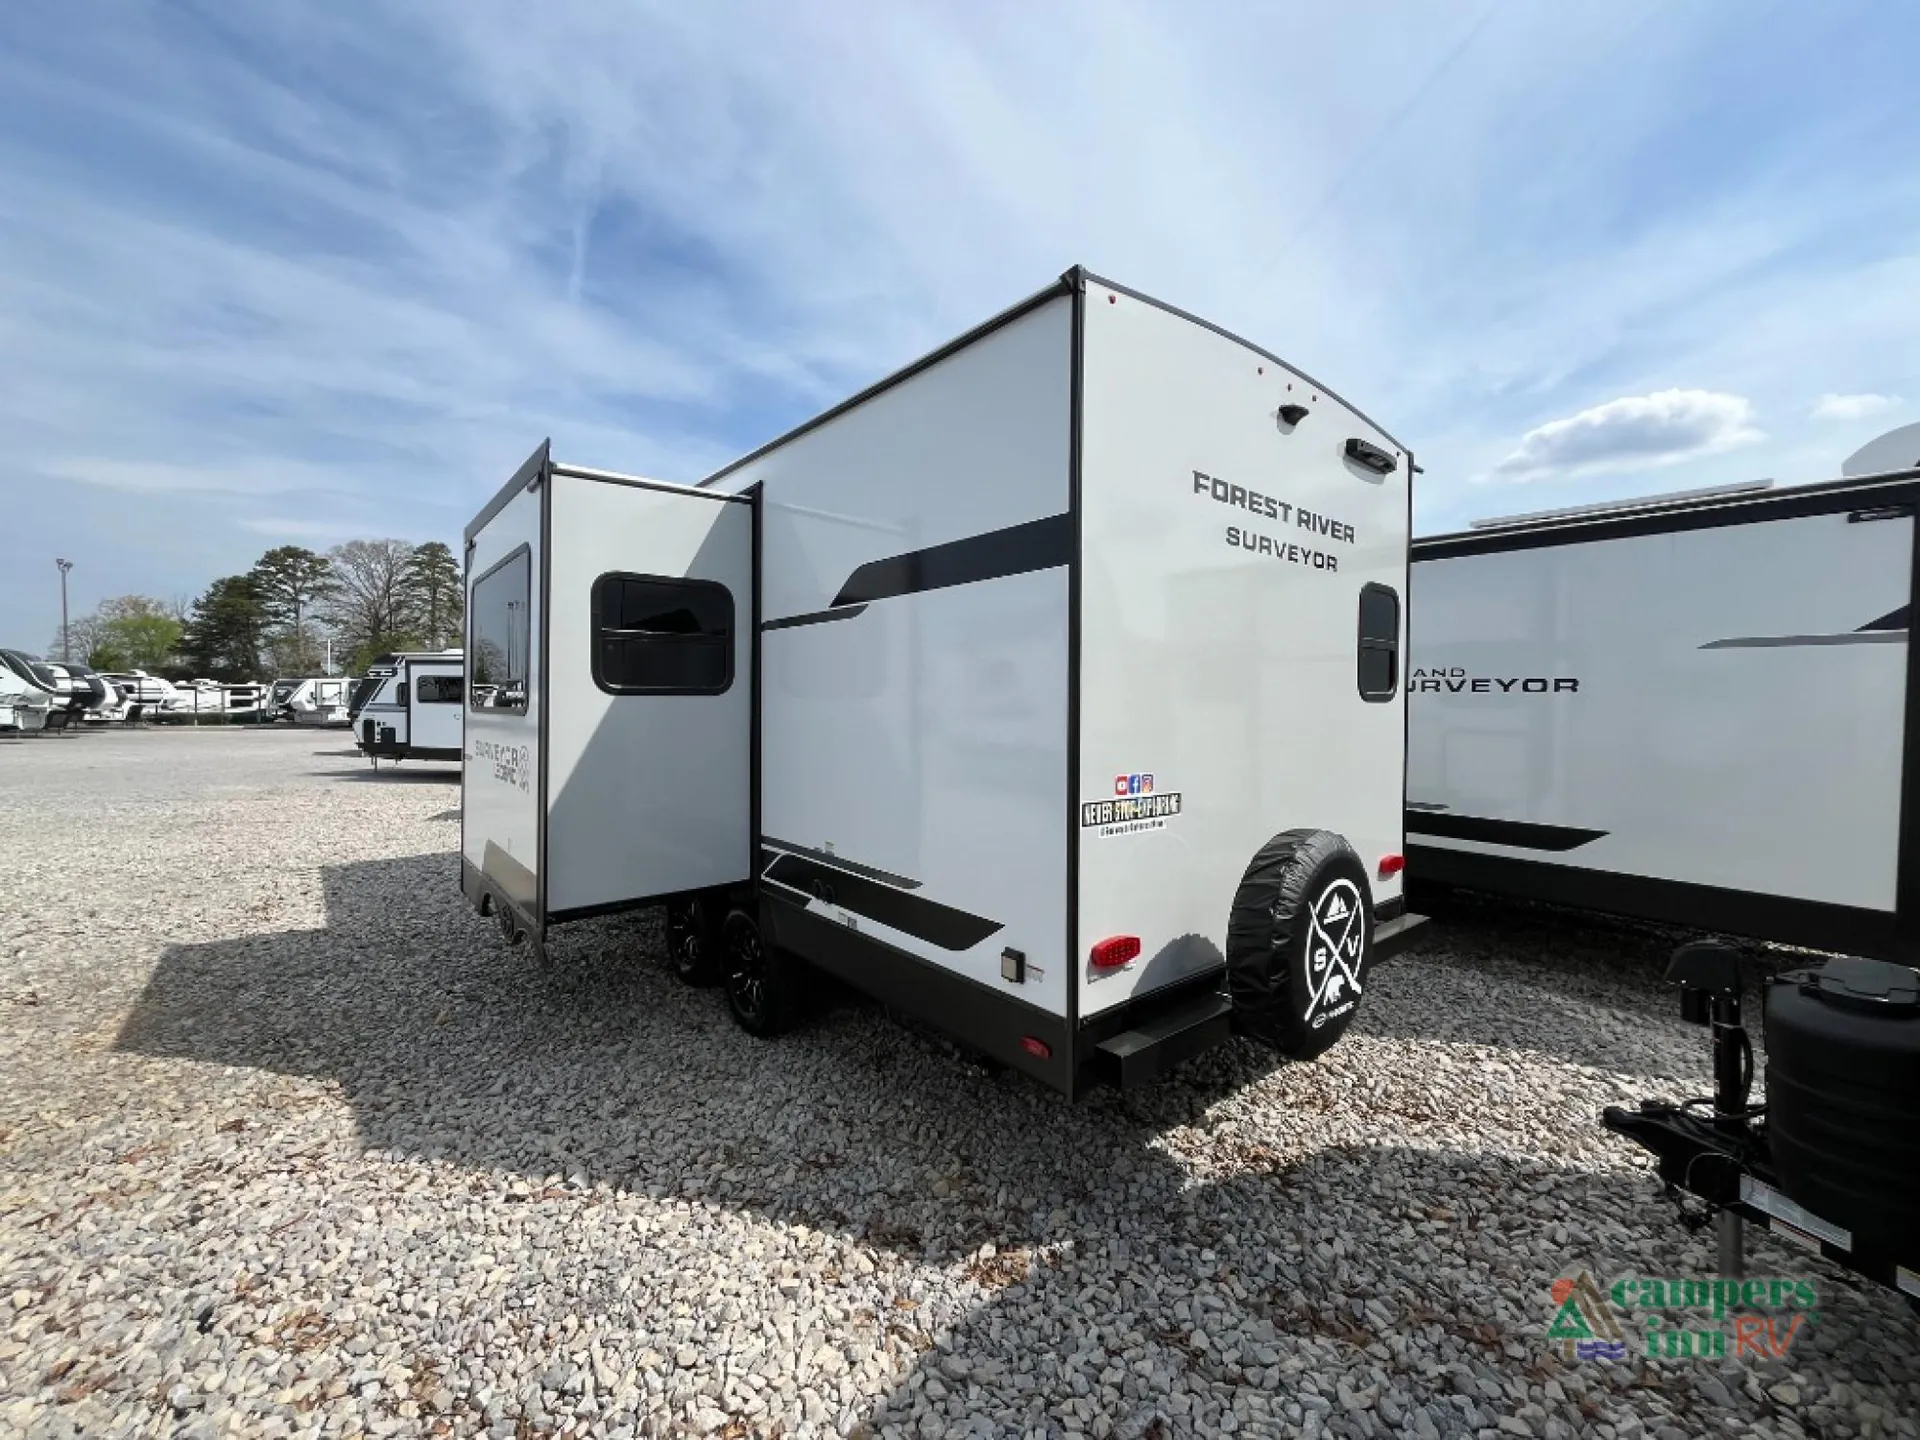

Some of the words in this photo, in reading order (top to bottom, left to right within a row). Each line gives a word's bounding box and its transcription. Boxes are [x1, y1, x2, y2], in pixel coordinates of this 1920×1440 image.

[1192, 469, 1292, 524] FOREST
[1297, 507, 1356, 544] RIVER
[1226, 525, 1338, 572] SURVEYOR
[1413, 667, 1465, 678] AND
